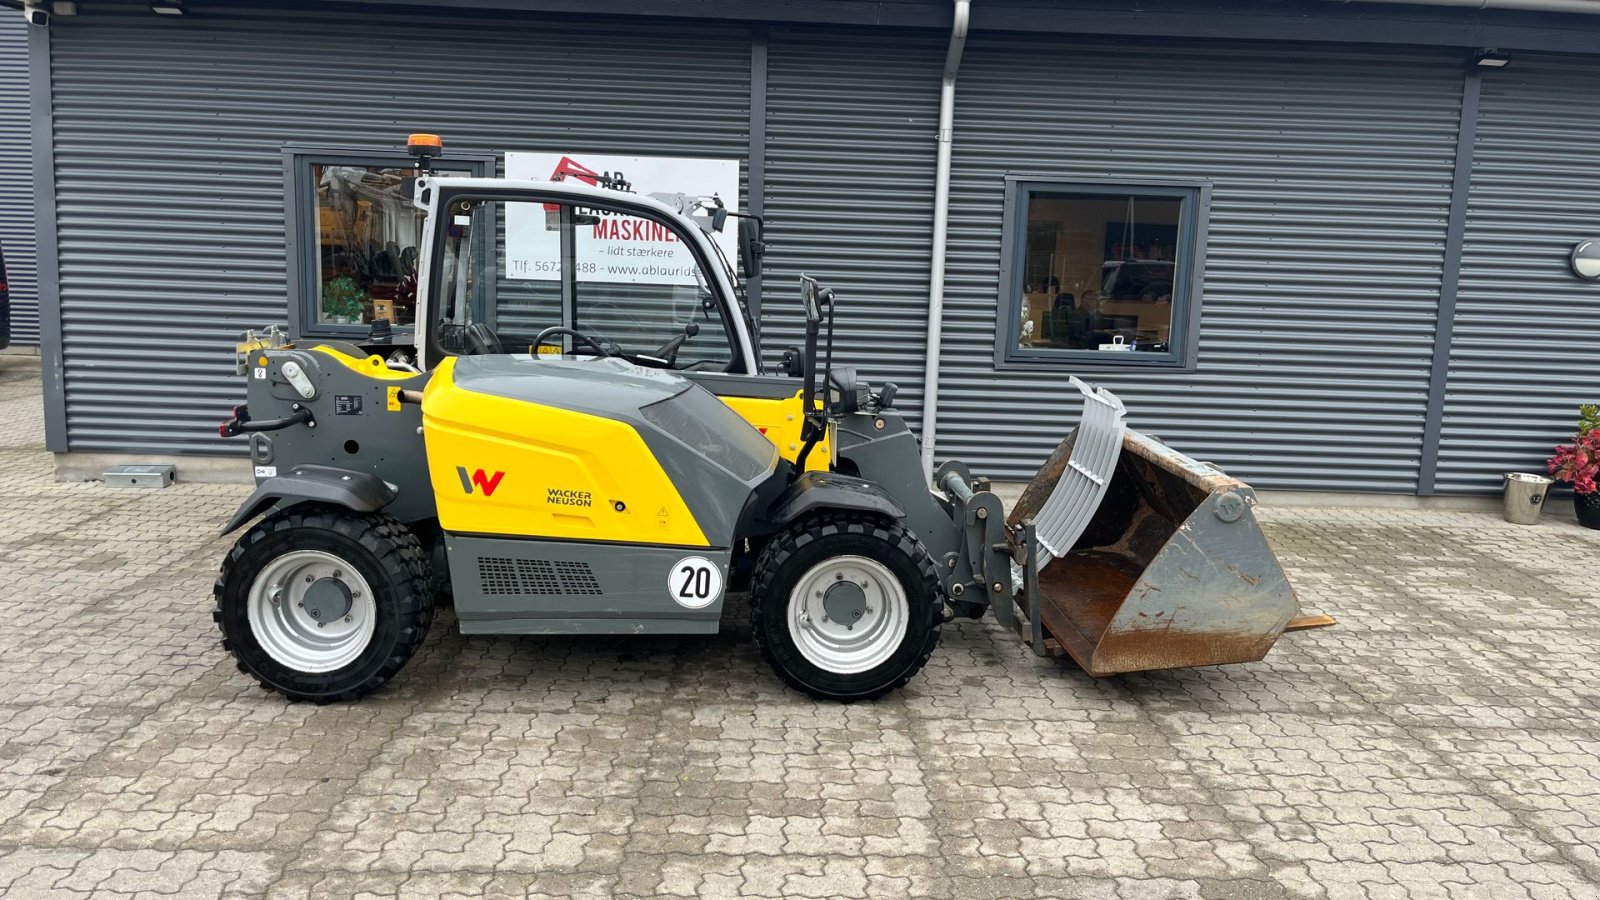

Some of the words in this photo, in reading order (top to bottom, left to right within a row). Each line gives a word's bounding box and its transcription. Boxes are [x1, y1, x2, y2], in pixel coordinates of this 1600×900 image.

[607, 245, 625, 256] lidt
[626, 246, 674, 258] stærkere
[513, 259, 531, 273] Tlf.
[547, 488, 592, 499] WACKER
[547, 497, 592, 507] NEUSON
[679, 566, 711, 599] 20
